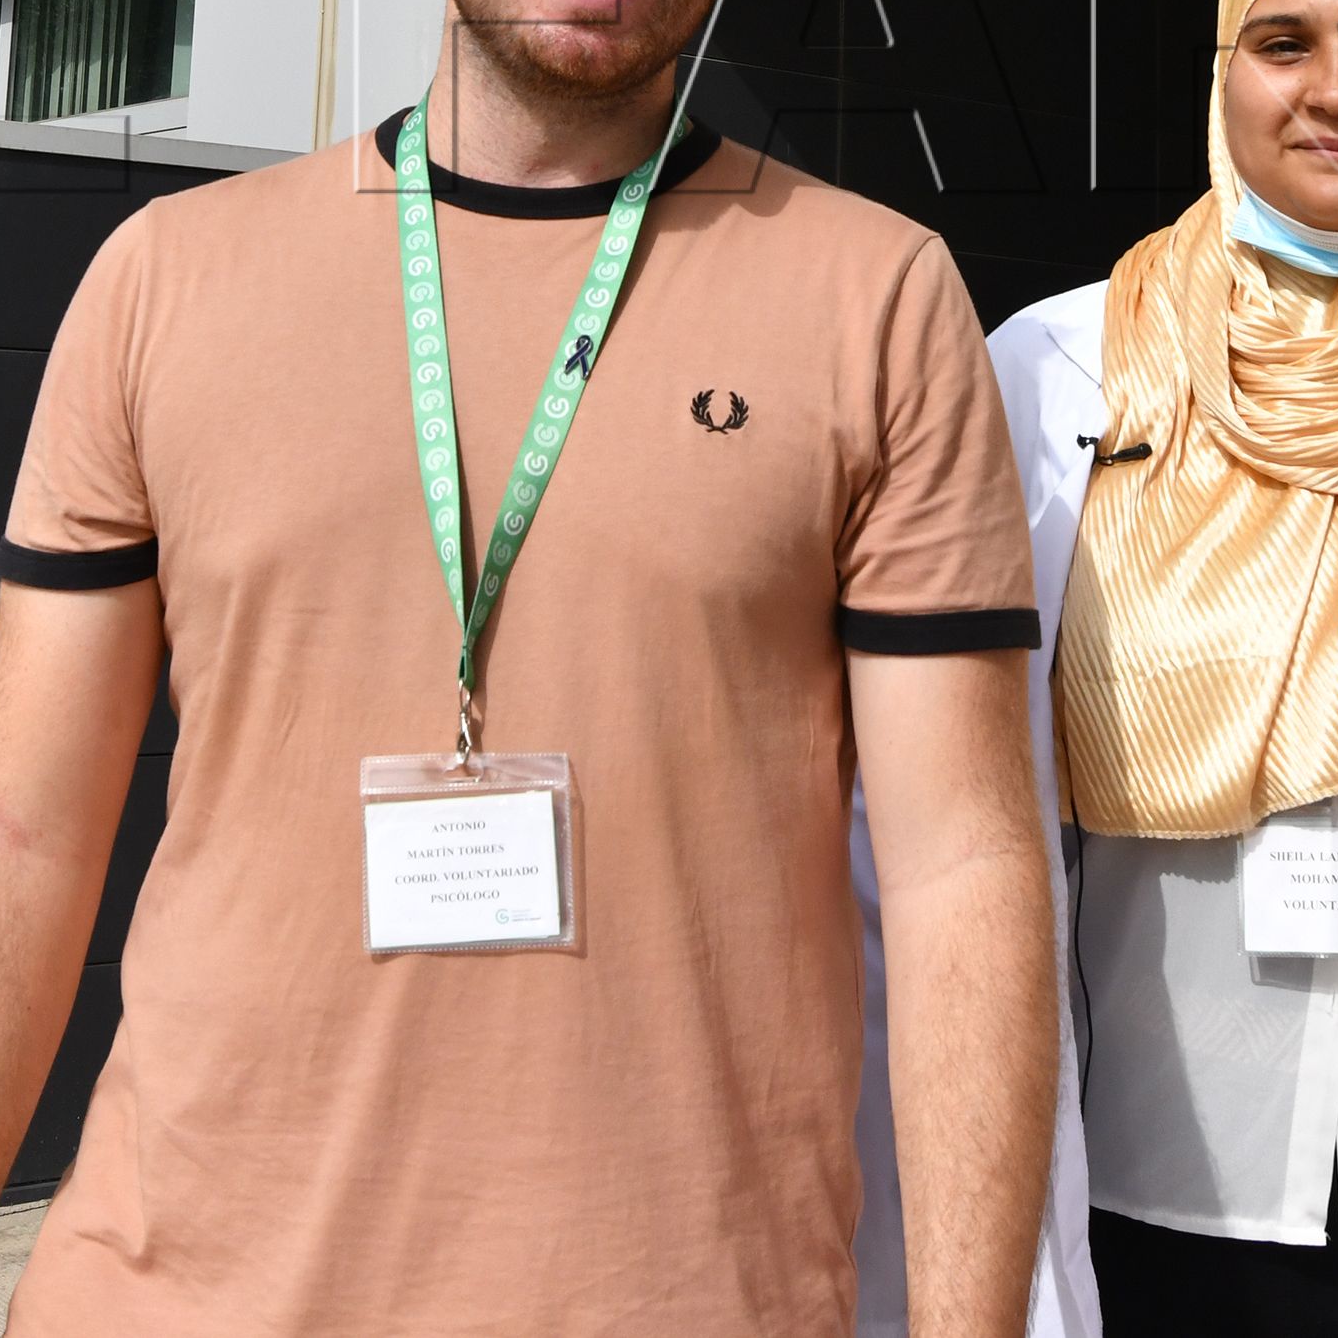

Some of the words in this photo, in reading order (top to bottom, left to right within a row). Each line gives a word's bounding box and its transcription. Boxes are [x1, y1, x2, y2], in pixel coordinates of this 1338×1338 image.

[431, 820, 487, 834] ANTONIO
[407, 845, 455, 861] MARTÍN
[458, 843, 506, 857] TORRES
[1269, 851, 1315, 863] SHEILA
[394, 873, 441, 886] COORD.
[442, 865, 540, 882] VOLUNTARIADO
